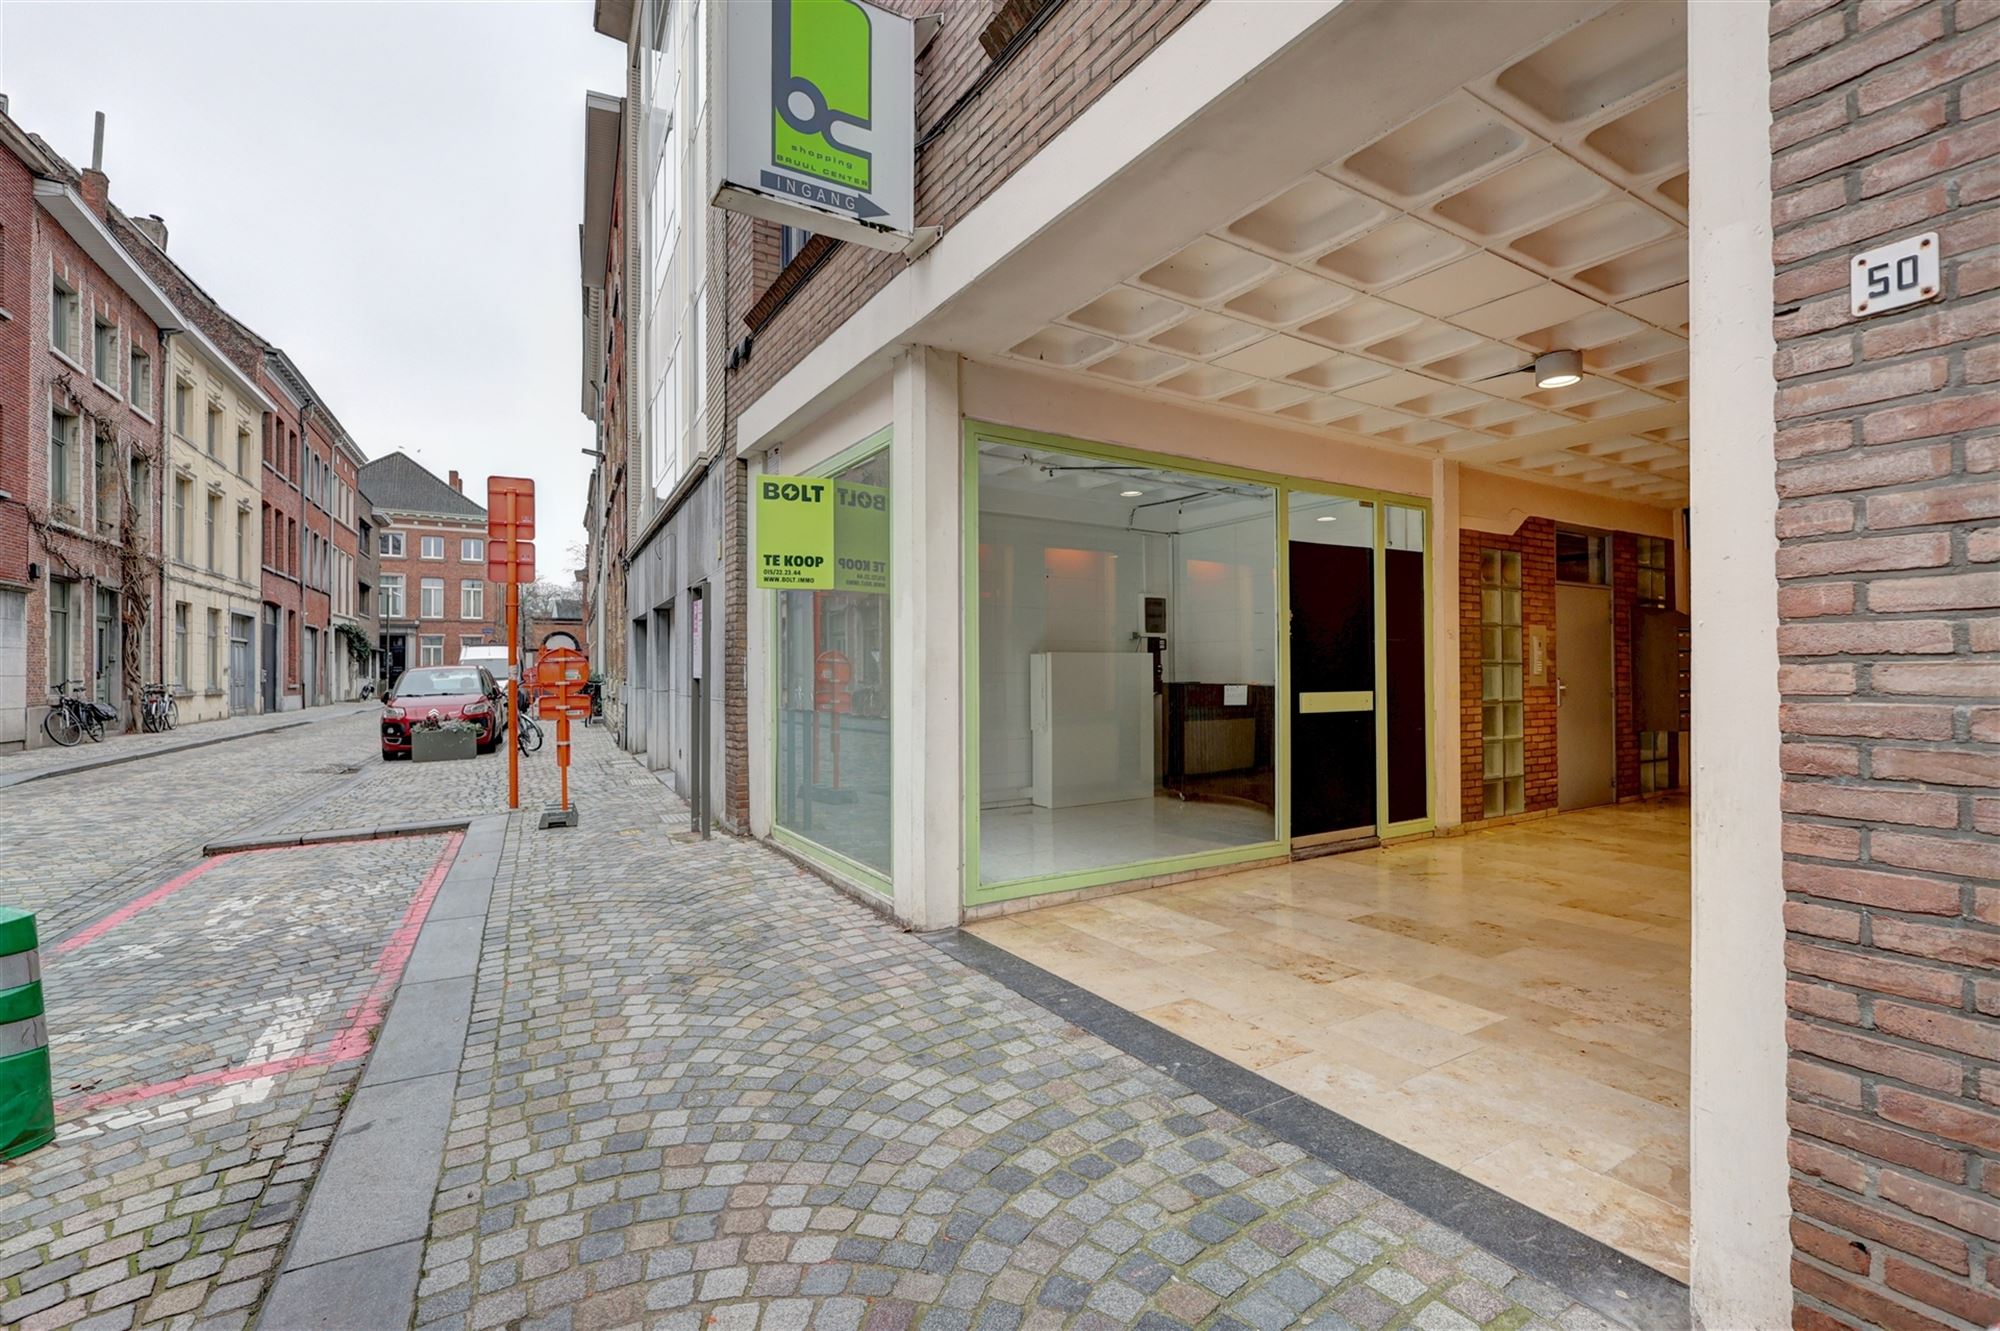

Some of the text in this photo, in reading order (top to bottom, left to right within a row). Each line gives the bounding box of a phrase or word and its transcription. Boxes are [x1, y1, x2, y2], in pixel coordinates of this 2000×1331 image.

[776, 154, 869, 187] BRUUL CENTER
[791, 145, 854, 170] shopping
[776, 176, 856, 210] INGANG
[1868, 254, 1919, 300] 50
[763, 482, 824, 503] BOLT
[763, 554, 824, 568] TE KOOP
